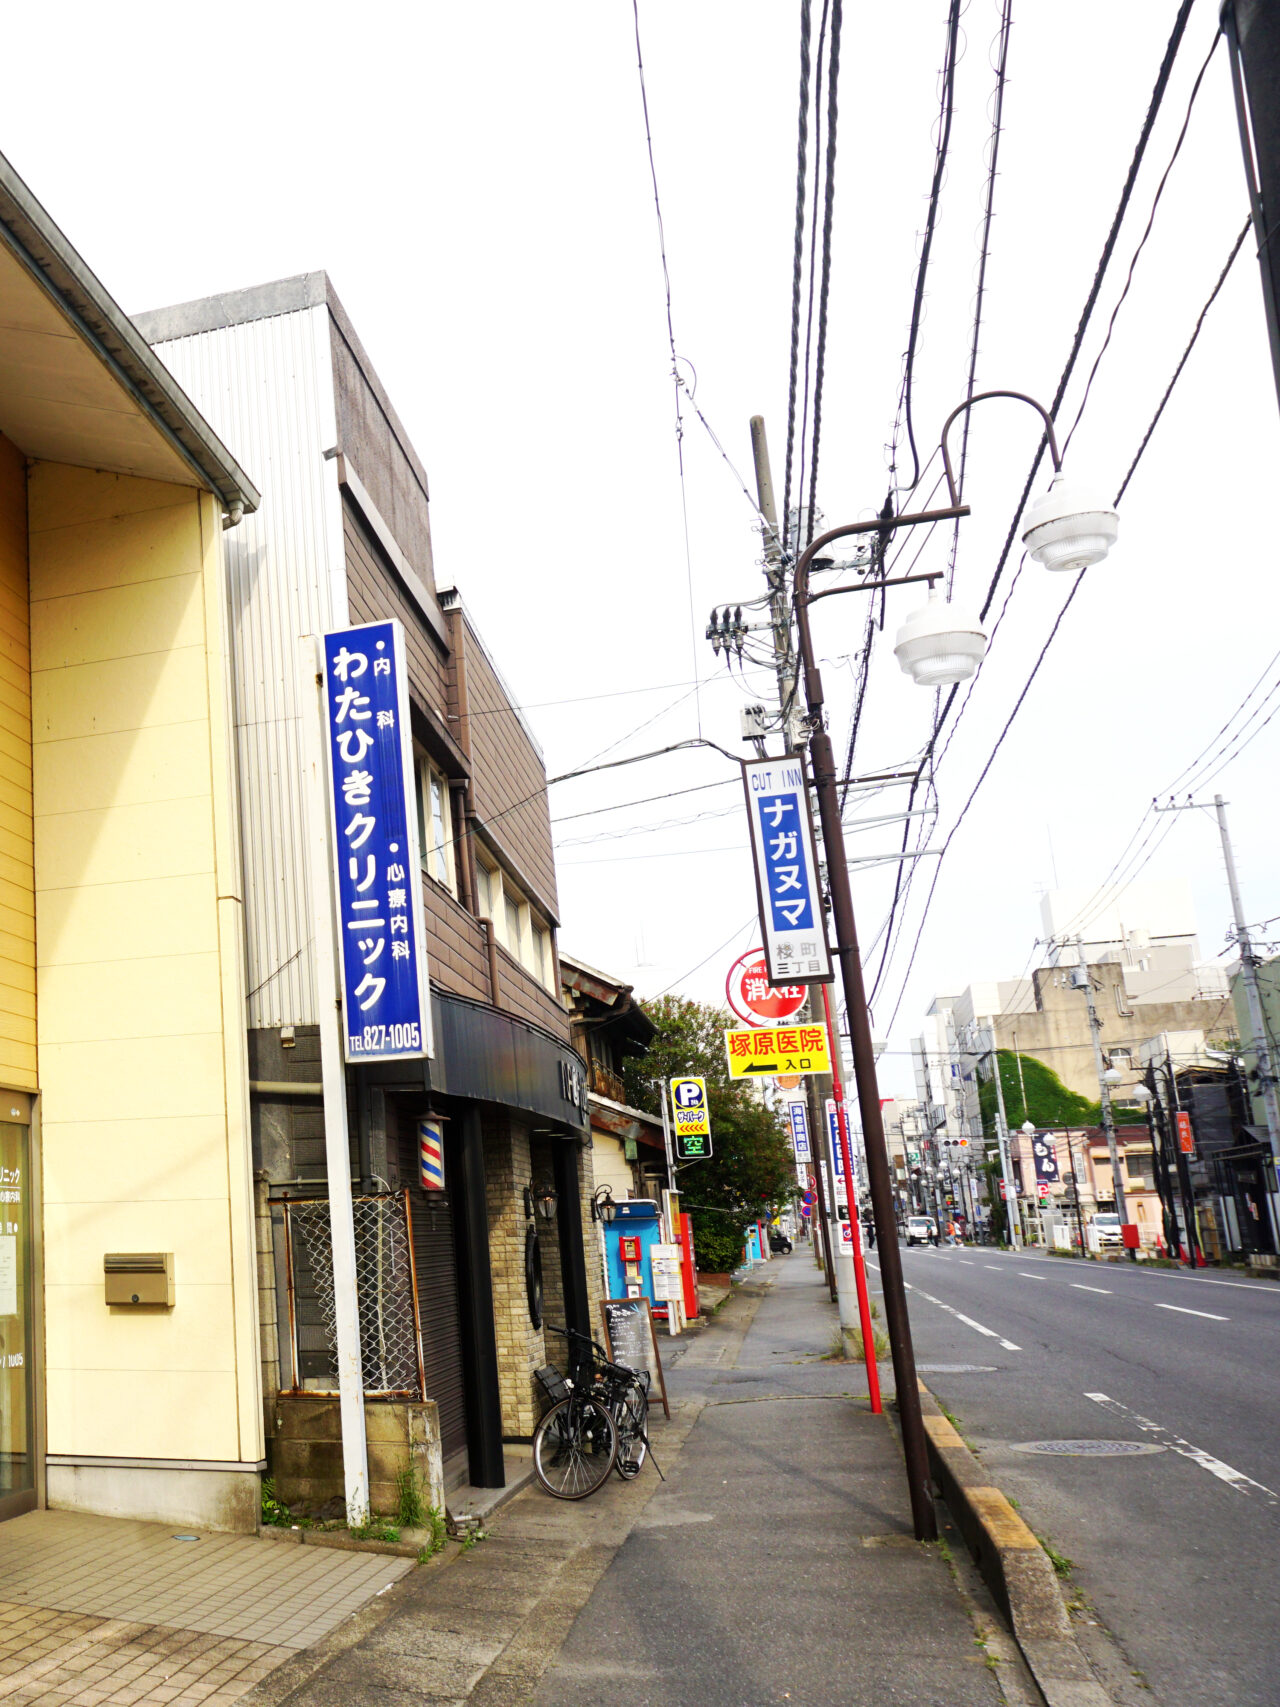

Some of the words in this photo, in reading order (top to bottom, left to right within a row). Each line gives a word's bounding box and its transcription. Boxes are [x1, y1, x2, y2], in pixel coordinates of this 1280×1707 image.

[373, 657, 395, 729] 内科
[751, 772, 773, 792] CUT
[781, 767, 803, 788] INN
[332, 646, 387, 1011] わたひきクリニック
[763, 798, 807, 927] ナガヌマ
[386, 862, 411, 961] 心療内科
[748, 966, 763, 975] FIRE
[777, 959, 822, 975] 三丁目
[349, 1035, 365, 1052] TEL
[363, 1023, 420, 1051] 827-1005
[728, 1028, 825, 1058] 塚原医院
[785, 1058, 812, 1071] 入口
[679, 1083, 700, 1106] P
[683, 1136, 705, 1156] 空
